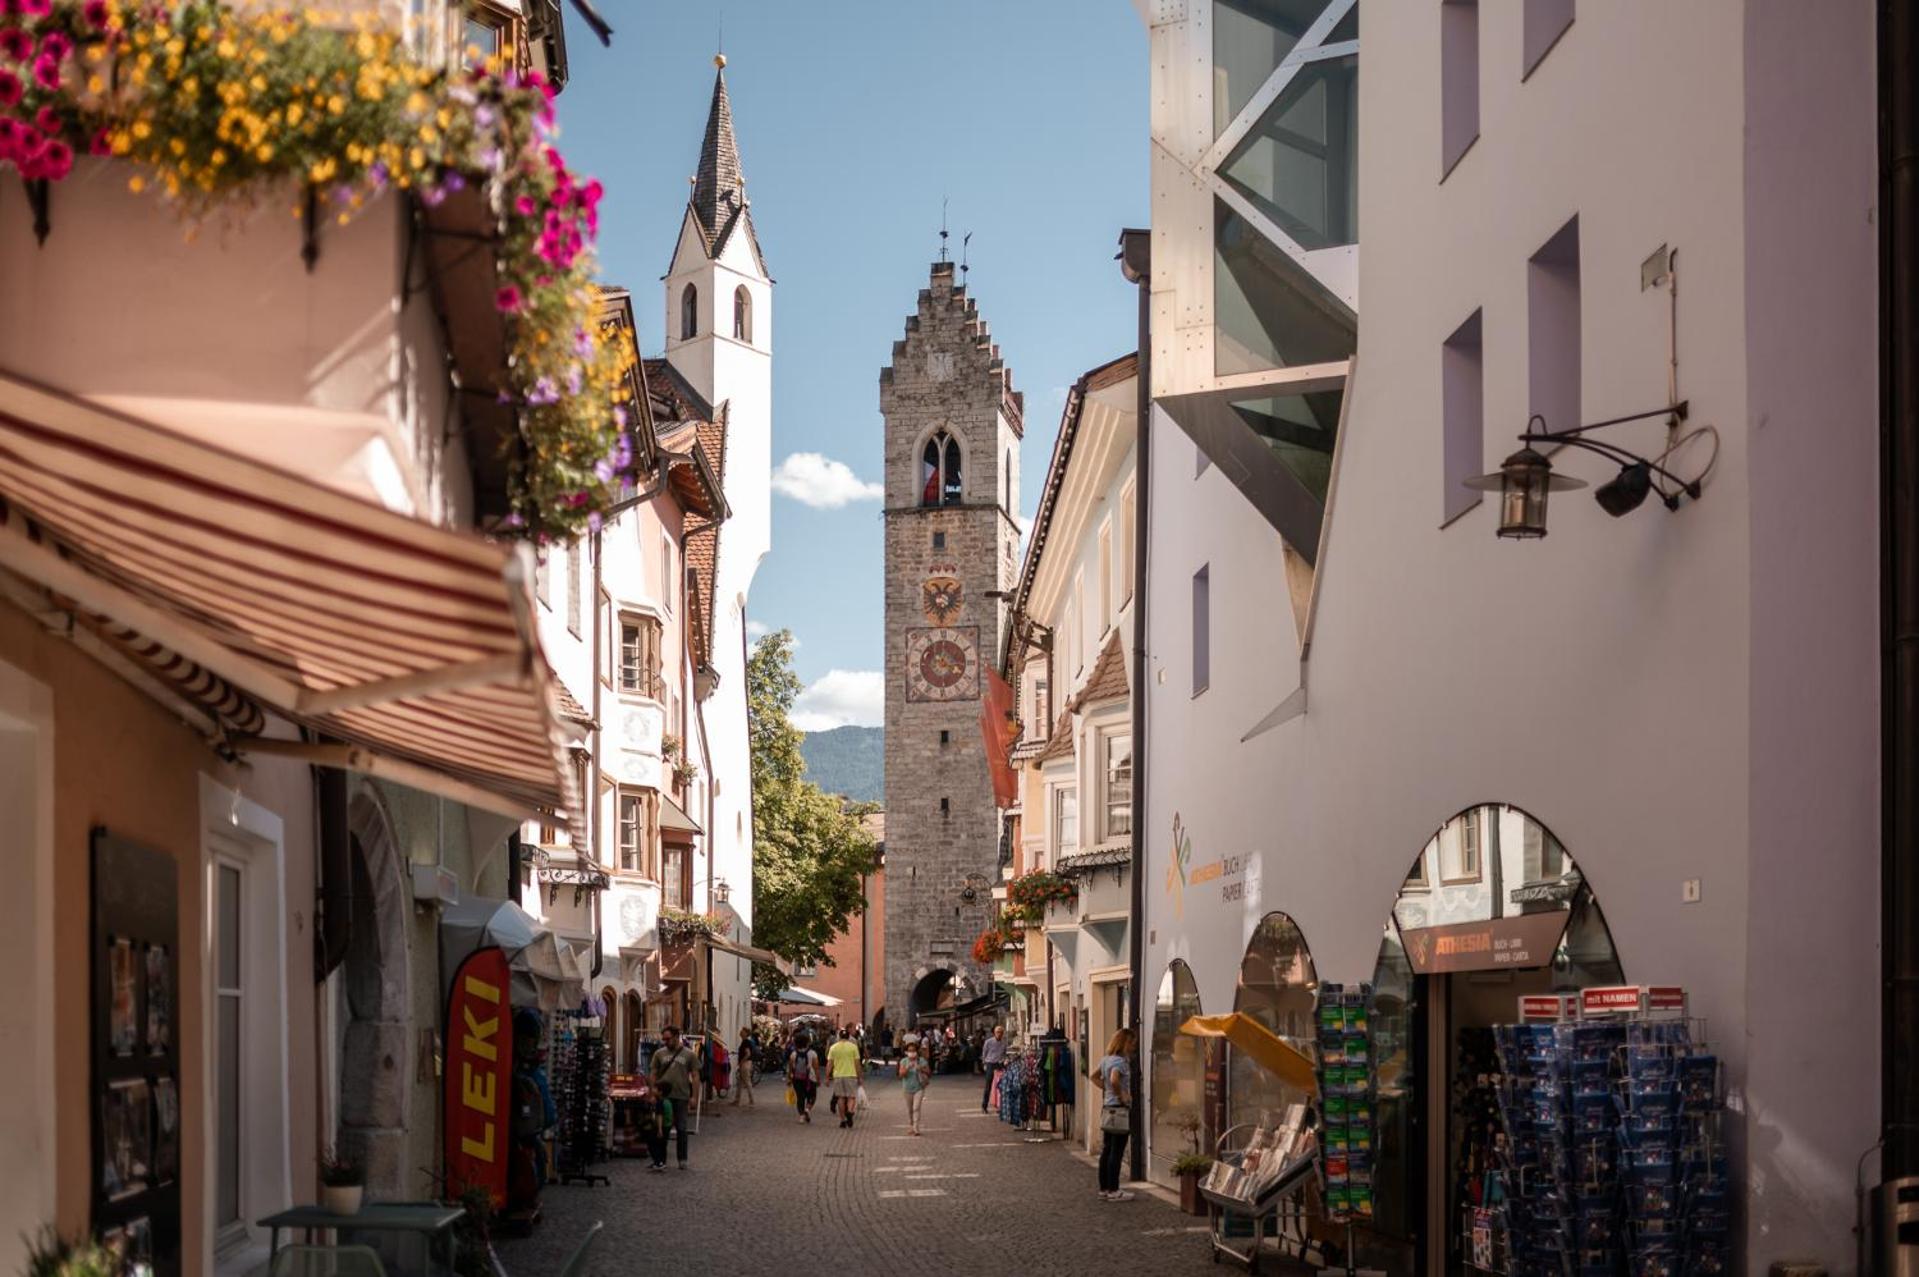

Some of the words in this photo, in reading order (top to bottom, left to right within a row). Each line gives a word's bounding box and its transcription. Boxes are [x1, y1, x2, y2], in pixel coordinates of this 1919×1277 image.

[1223, 856, 1239, 876] BUCH
[1436, 932, 1491, 955] ATHESIA
[1586, 996, 1601, 1005] mit
[1602, 993, 1637, 1004] NAMEN
[462, 975, 499, 1163] LEKI
